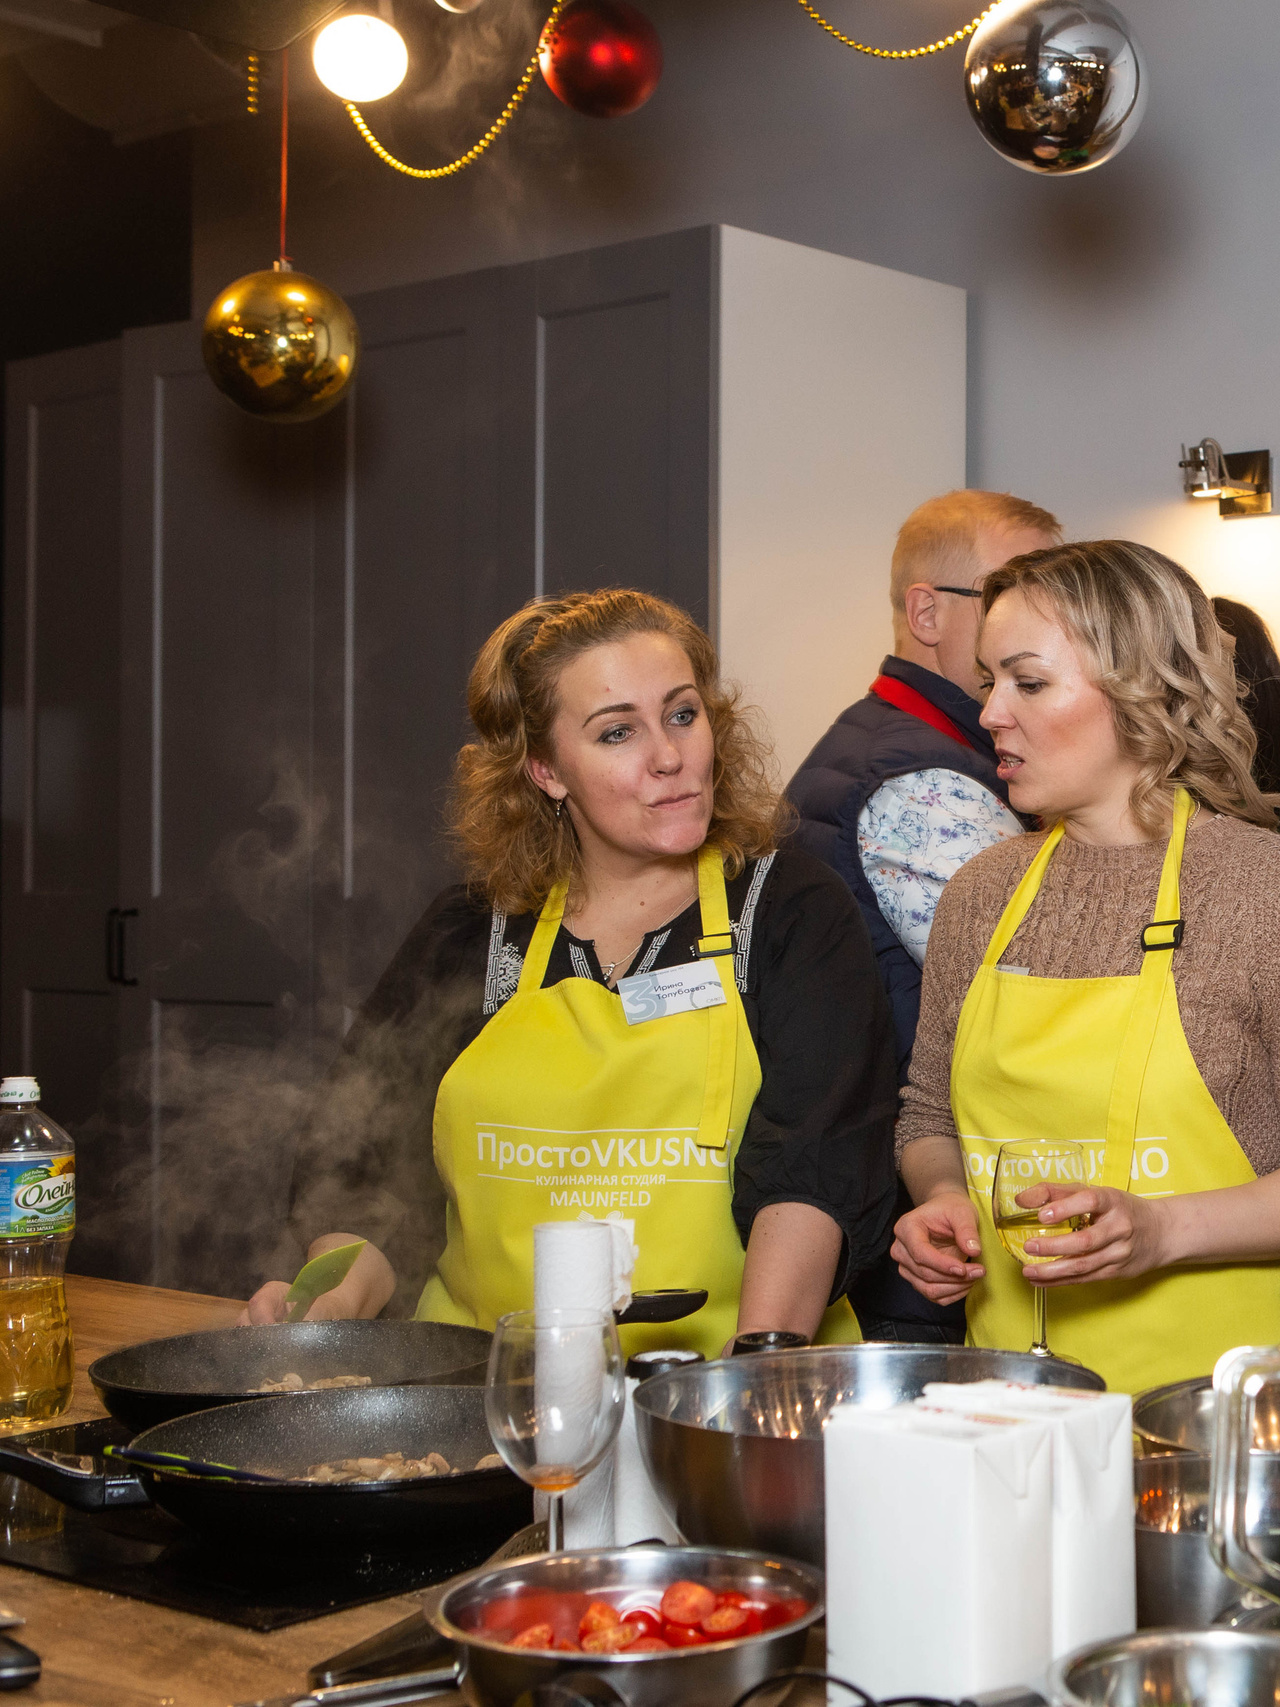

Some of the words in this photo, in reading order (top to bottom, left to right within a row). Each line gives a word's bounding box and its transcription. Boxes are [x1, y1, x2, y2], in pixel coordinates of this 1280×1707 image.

[653, 980, 684, 993] Ирина
[535, 1174, 618, 1186] КУЛИНАРНАЯ
[621, 1174, 666, 1186] СТУДИЯ
[22, 1181, 75, 1207] Олейн
[549, 1190, 651, 1207] MAUNFELD
